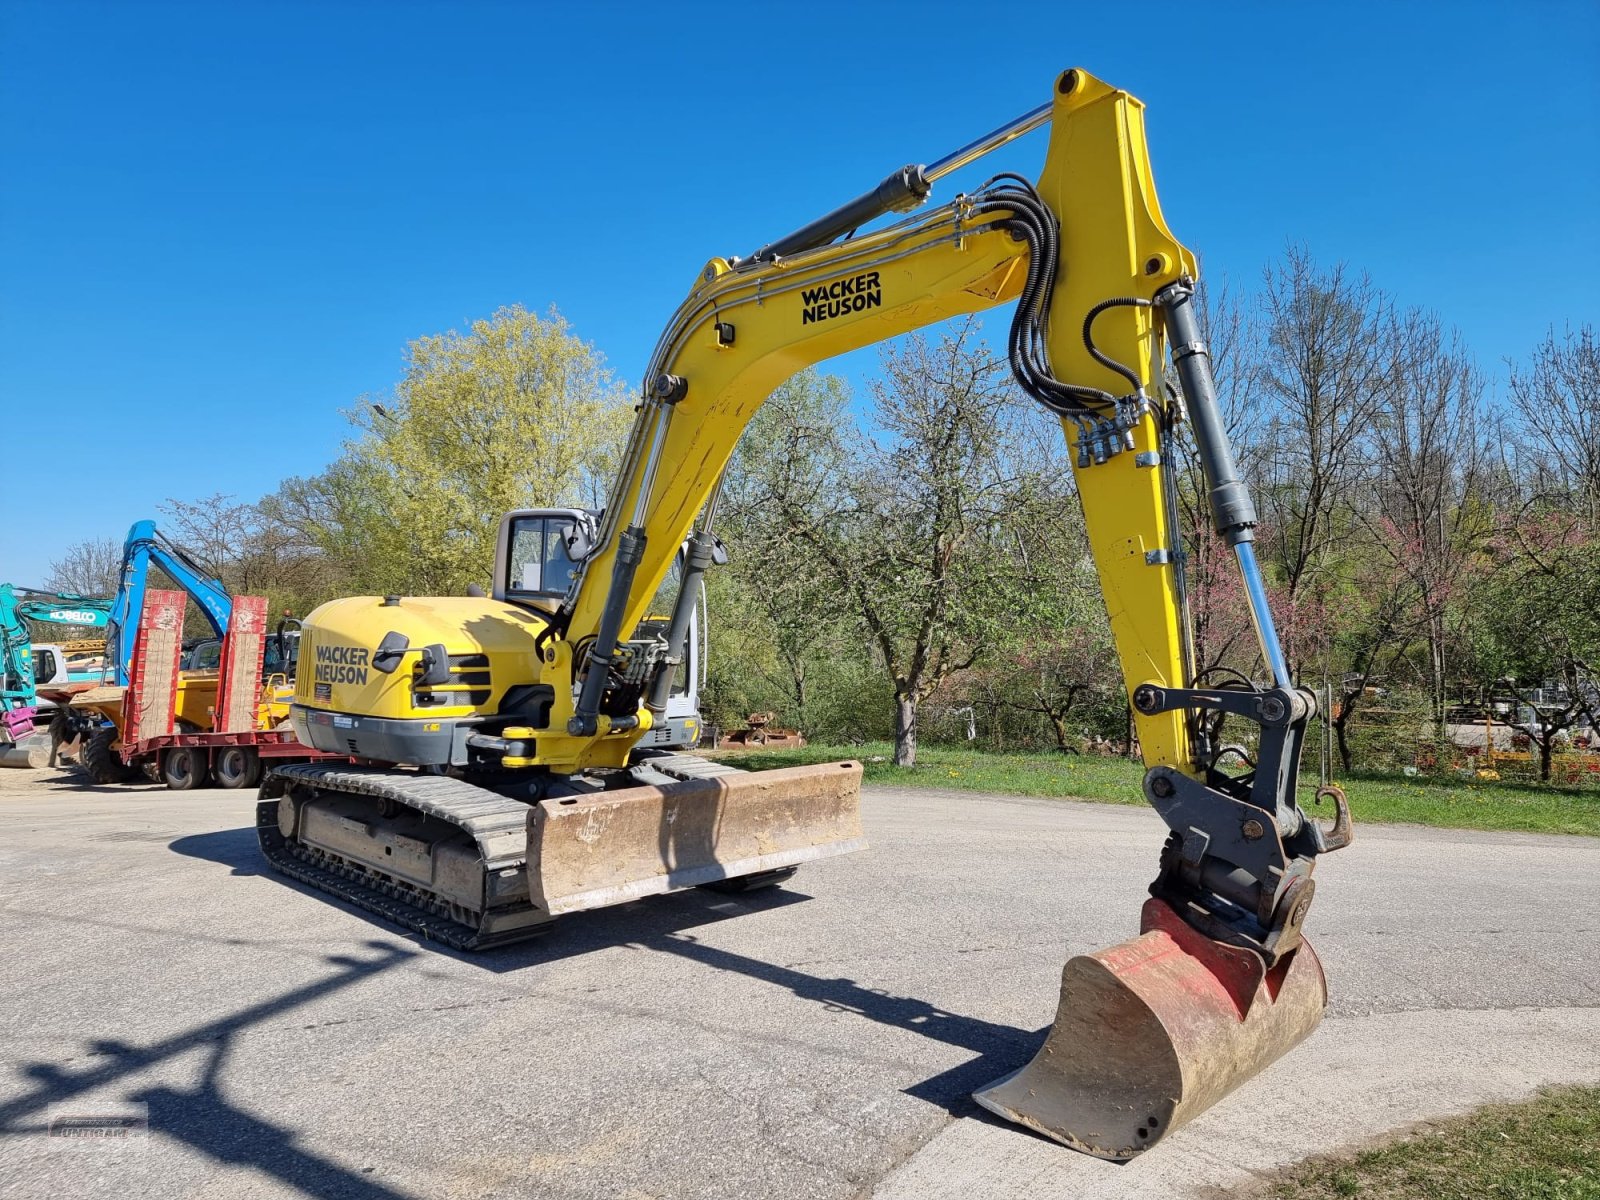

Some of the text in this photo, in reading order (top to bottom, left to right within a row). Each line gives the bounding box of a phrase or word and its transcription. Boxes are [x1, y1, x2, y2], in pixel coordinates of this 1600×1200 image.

[801, 272, 881, 306] WACKER
[803, 289, 881, 325] NEUSON
[50, 610, 96, 623] KOBELCO
[316, 645, 369, 666] WACKER
[315, 663, 368, 686] NEUSON
